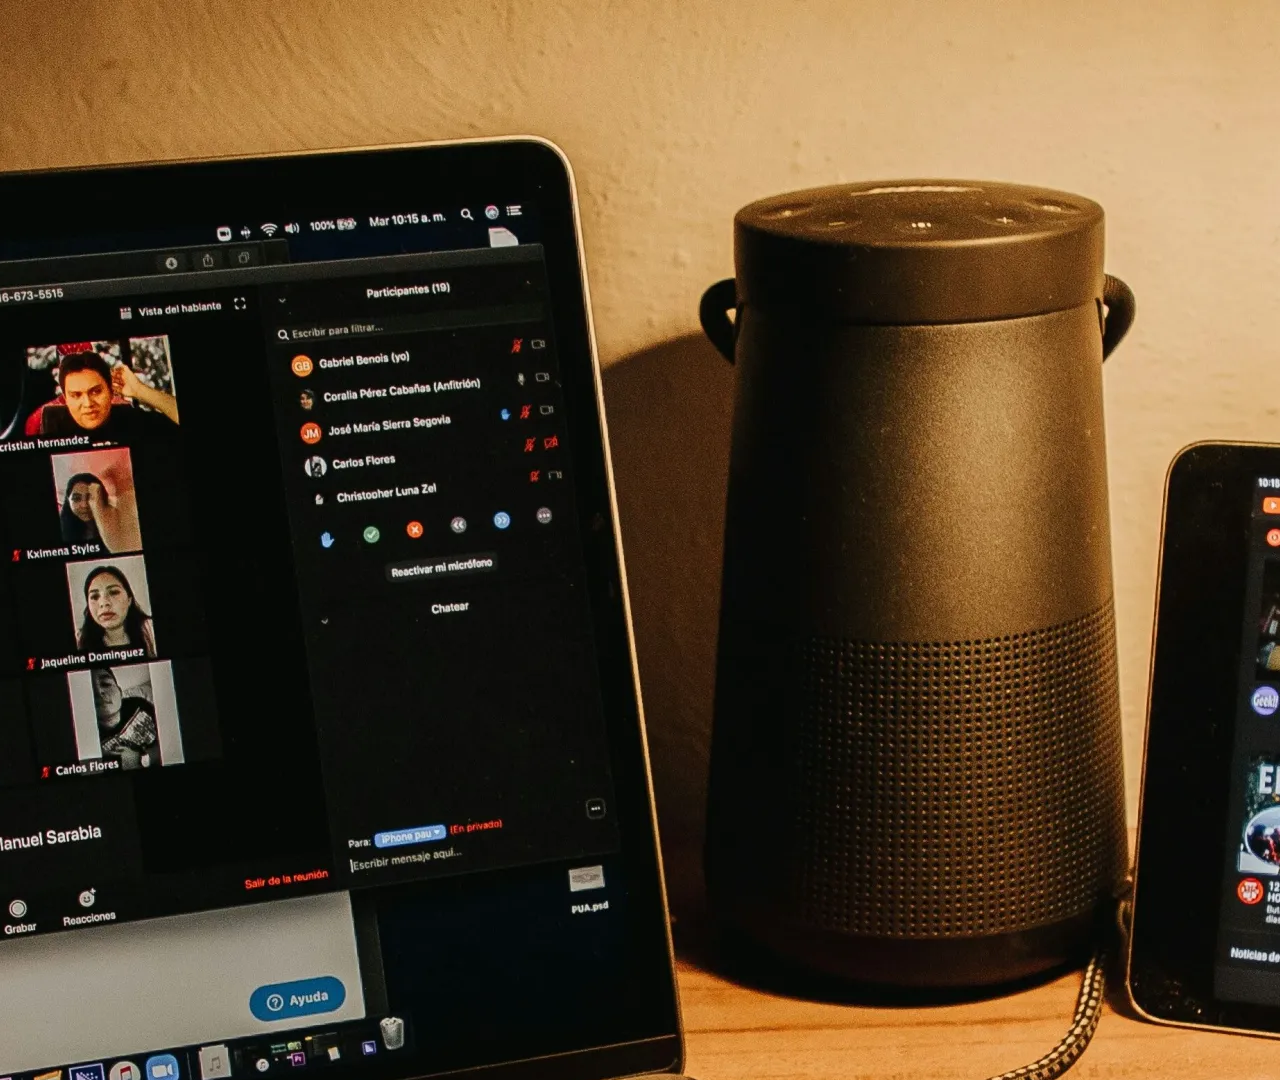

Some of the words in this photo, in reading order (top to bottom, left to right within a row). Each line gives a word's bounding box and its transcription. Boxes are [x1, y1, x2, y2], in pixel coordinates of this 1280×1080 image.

[310, 220, 335, 231] 100%
[366, 284, 430, 299] Participantes
[432, 282, 451, 295] (19)
[138, 305, 163, 317] Vista
[164, 303, 180, 315] del
[181, 300, 222, 314] hablante
[319, 356, 355, 370] Gabriel
[356, 352, 389, 366] Benois
[390, 350, 410, 364] (yo)
[323, 390, 358, 403] Coralia
[359, 385, 388, 399] Pérez
[389, 381, 431, 396] Cabañas
[432, 377, 481, 393] (Anfitrión)
[37, 433, 90, 449] hernandez
[332, 457, 365, 470] Carlos
[366, 454, 396, 467] Flores
[26, 545, 69, 560] Kximena
[71, 541, 100, 557] Styles
[431, 601, 469, 615] Chatear
[40, 652, 86, 670] Jaqueline
[88, 646, 144, 665] Dominguez
[55, 763, 87, 777] Carlos
[88, 759, 119, 773] Flores
[45, 824, 102, 846] Sarabia
[571, 900, 610, 916] PUA.psd
[62, 910, 116, 928] Reacciones
[4, 921, 37, 936] Grabar
[1230, 947, 1267, 962] Noticias
[1268, 951, 1280, 963] de
[288, 990, 330, 1007] Ayuda
